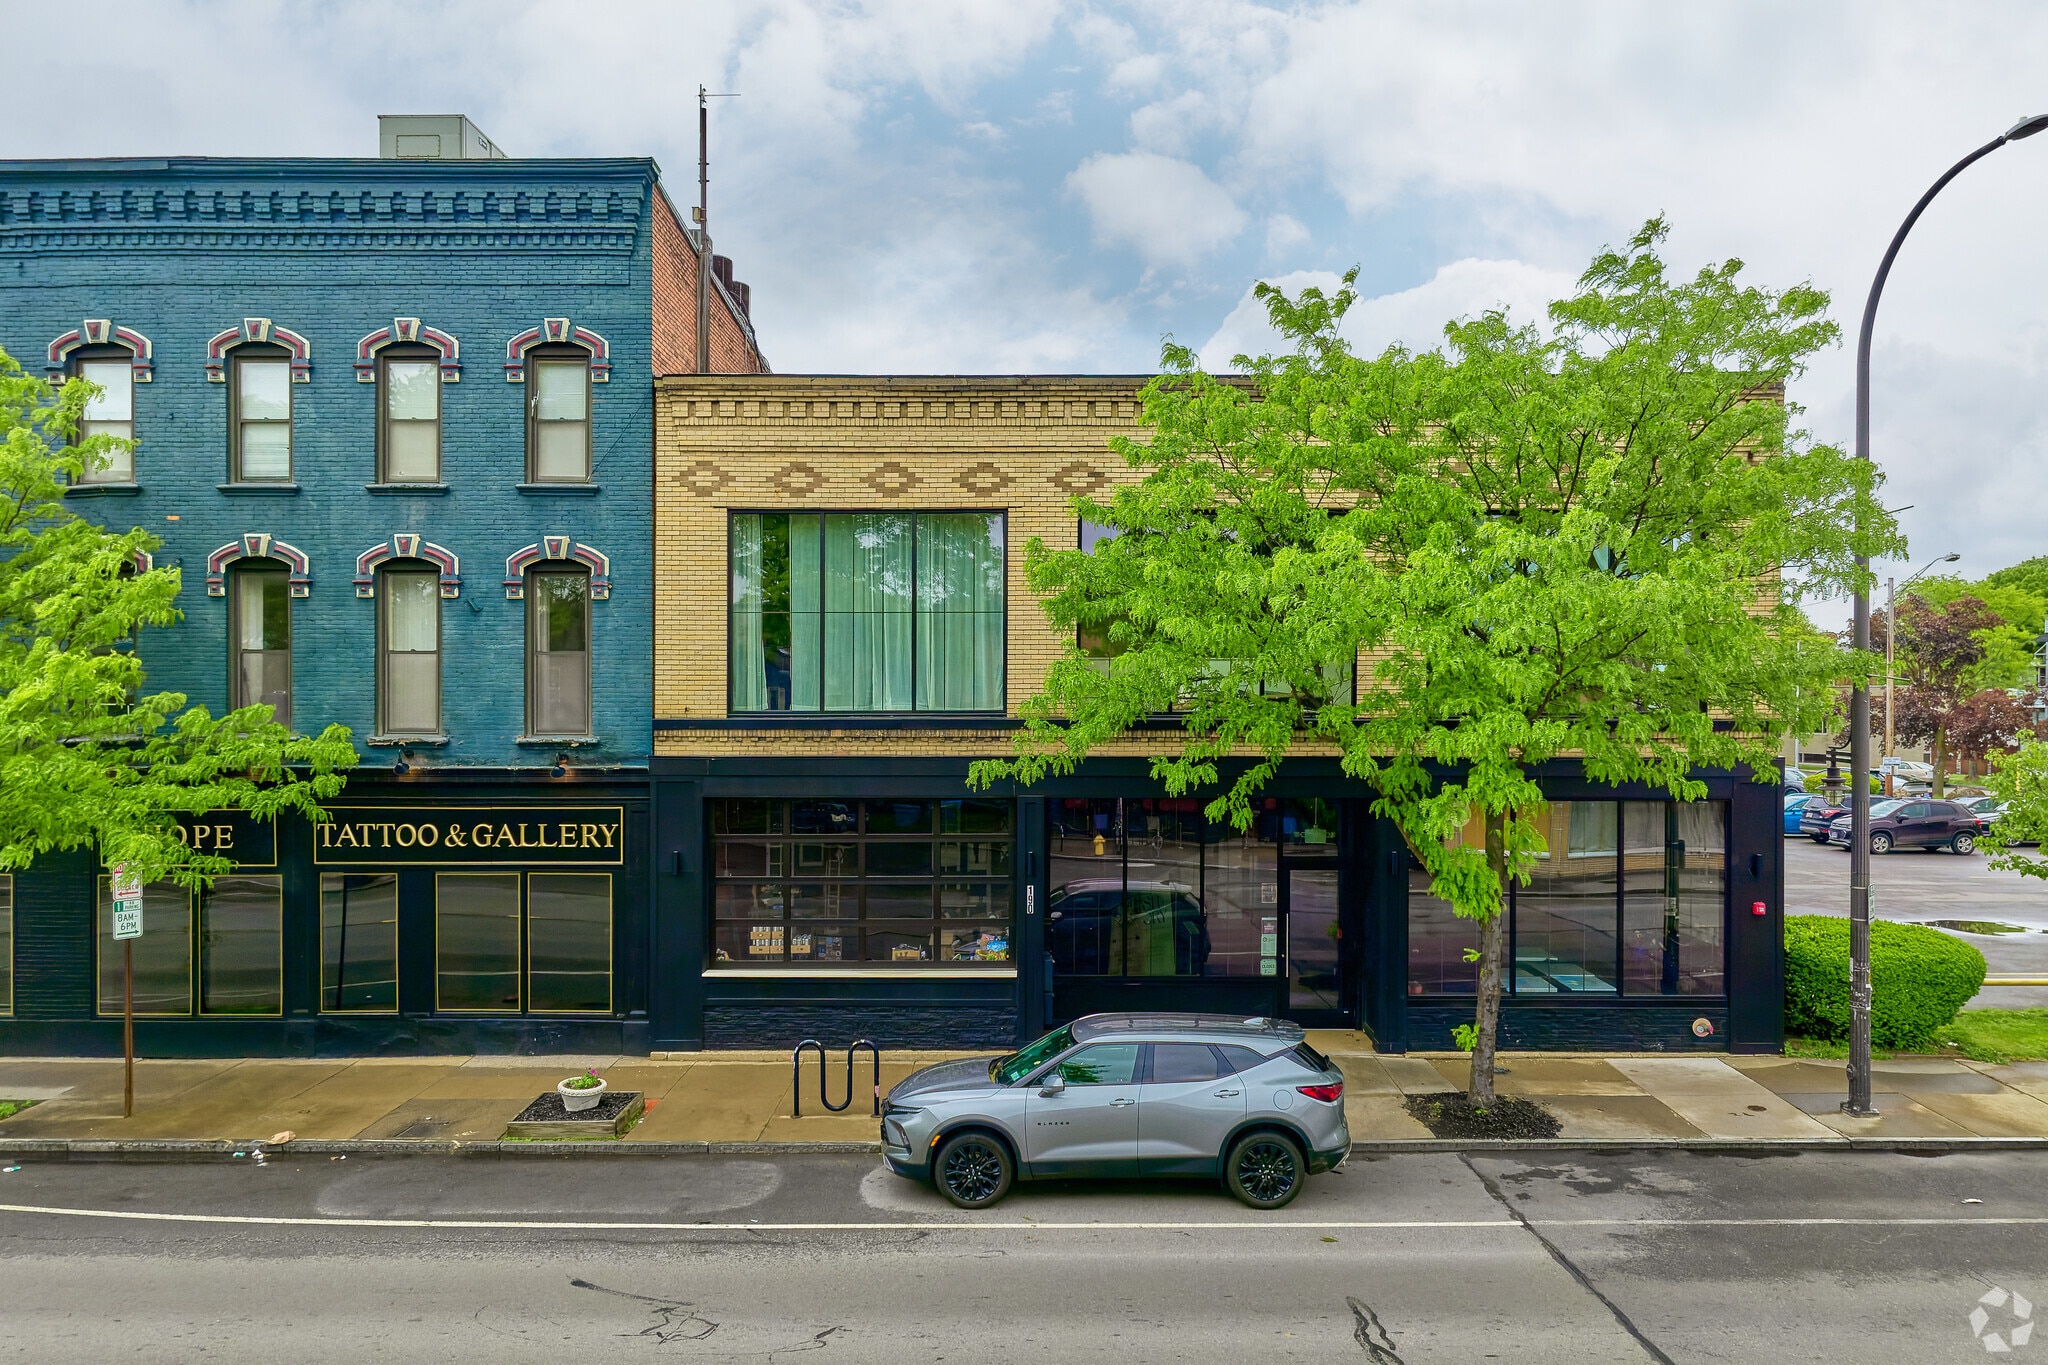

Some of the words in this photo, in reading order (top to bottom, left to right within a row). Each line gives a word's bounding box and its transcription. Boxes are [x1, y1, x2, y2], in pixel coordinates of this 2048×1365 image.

[146, 824, 234, 849] OPE
[316, 823, 439, 848] TATTOO
[444, 823, 468, 848] &
[471, 823, 619, 848] GALLERY
[120, 922, 137, 931] 6PM
